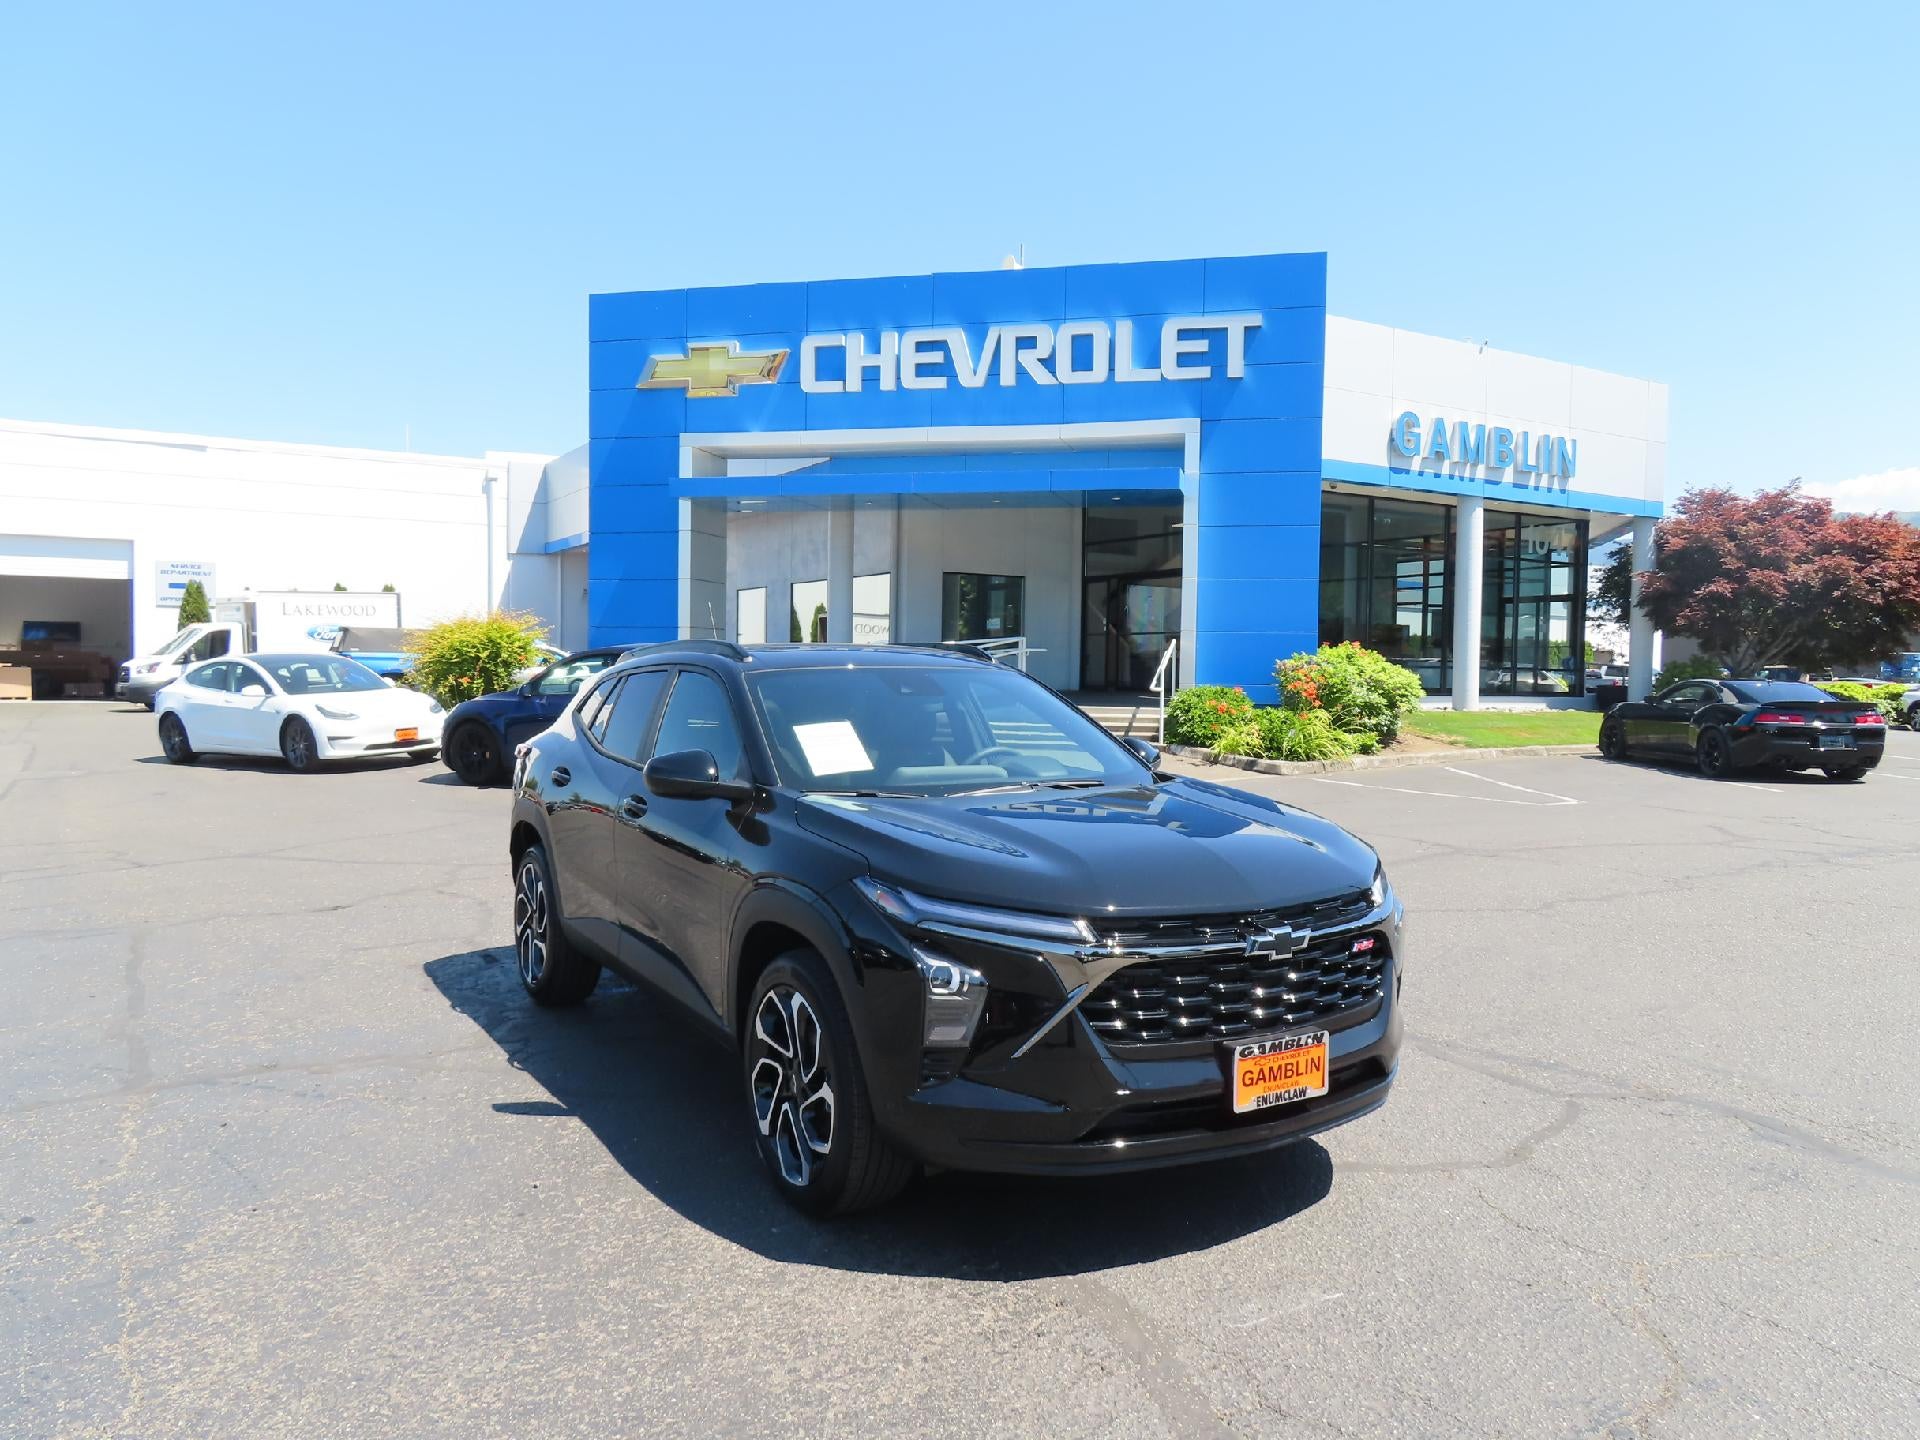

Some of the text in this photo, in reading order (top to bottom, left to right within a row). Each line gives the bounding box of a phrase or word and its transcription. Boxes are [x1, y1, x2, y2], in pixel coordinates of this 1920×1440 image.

[800, 313, 1262, 393] CHEVROLET
[1394, 411, 1577, 478] GAMBLIN
[282, 601, 377, 617] LAKEWOOD
[1239, 1032, 1325, 1058] GAMBLIN
[1242, 1056, 1321, 1088] GAMBLIN
[1256, 1086, 1308, 1108] ENUMCLAW
